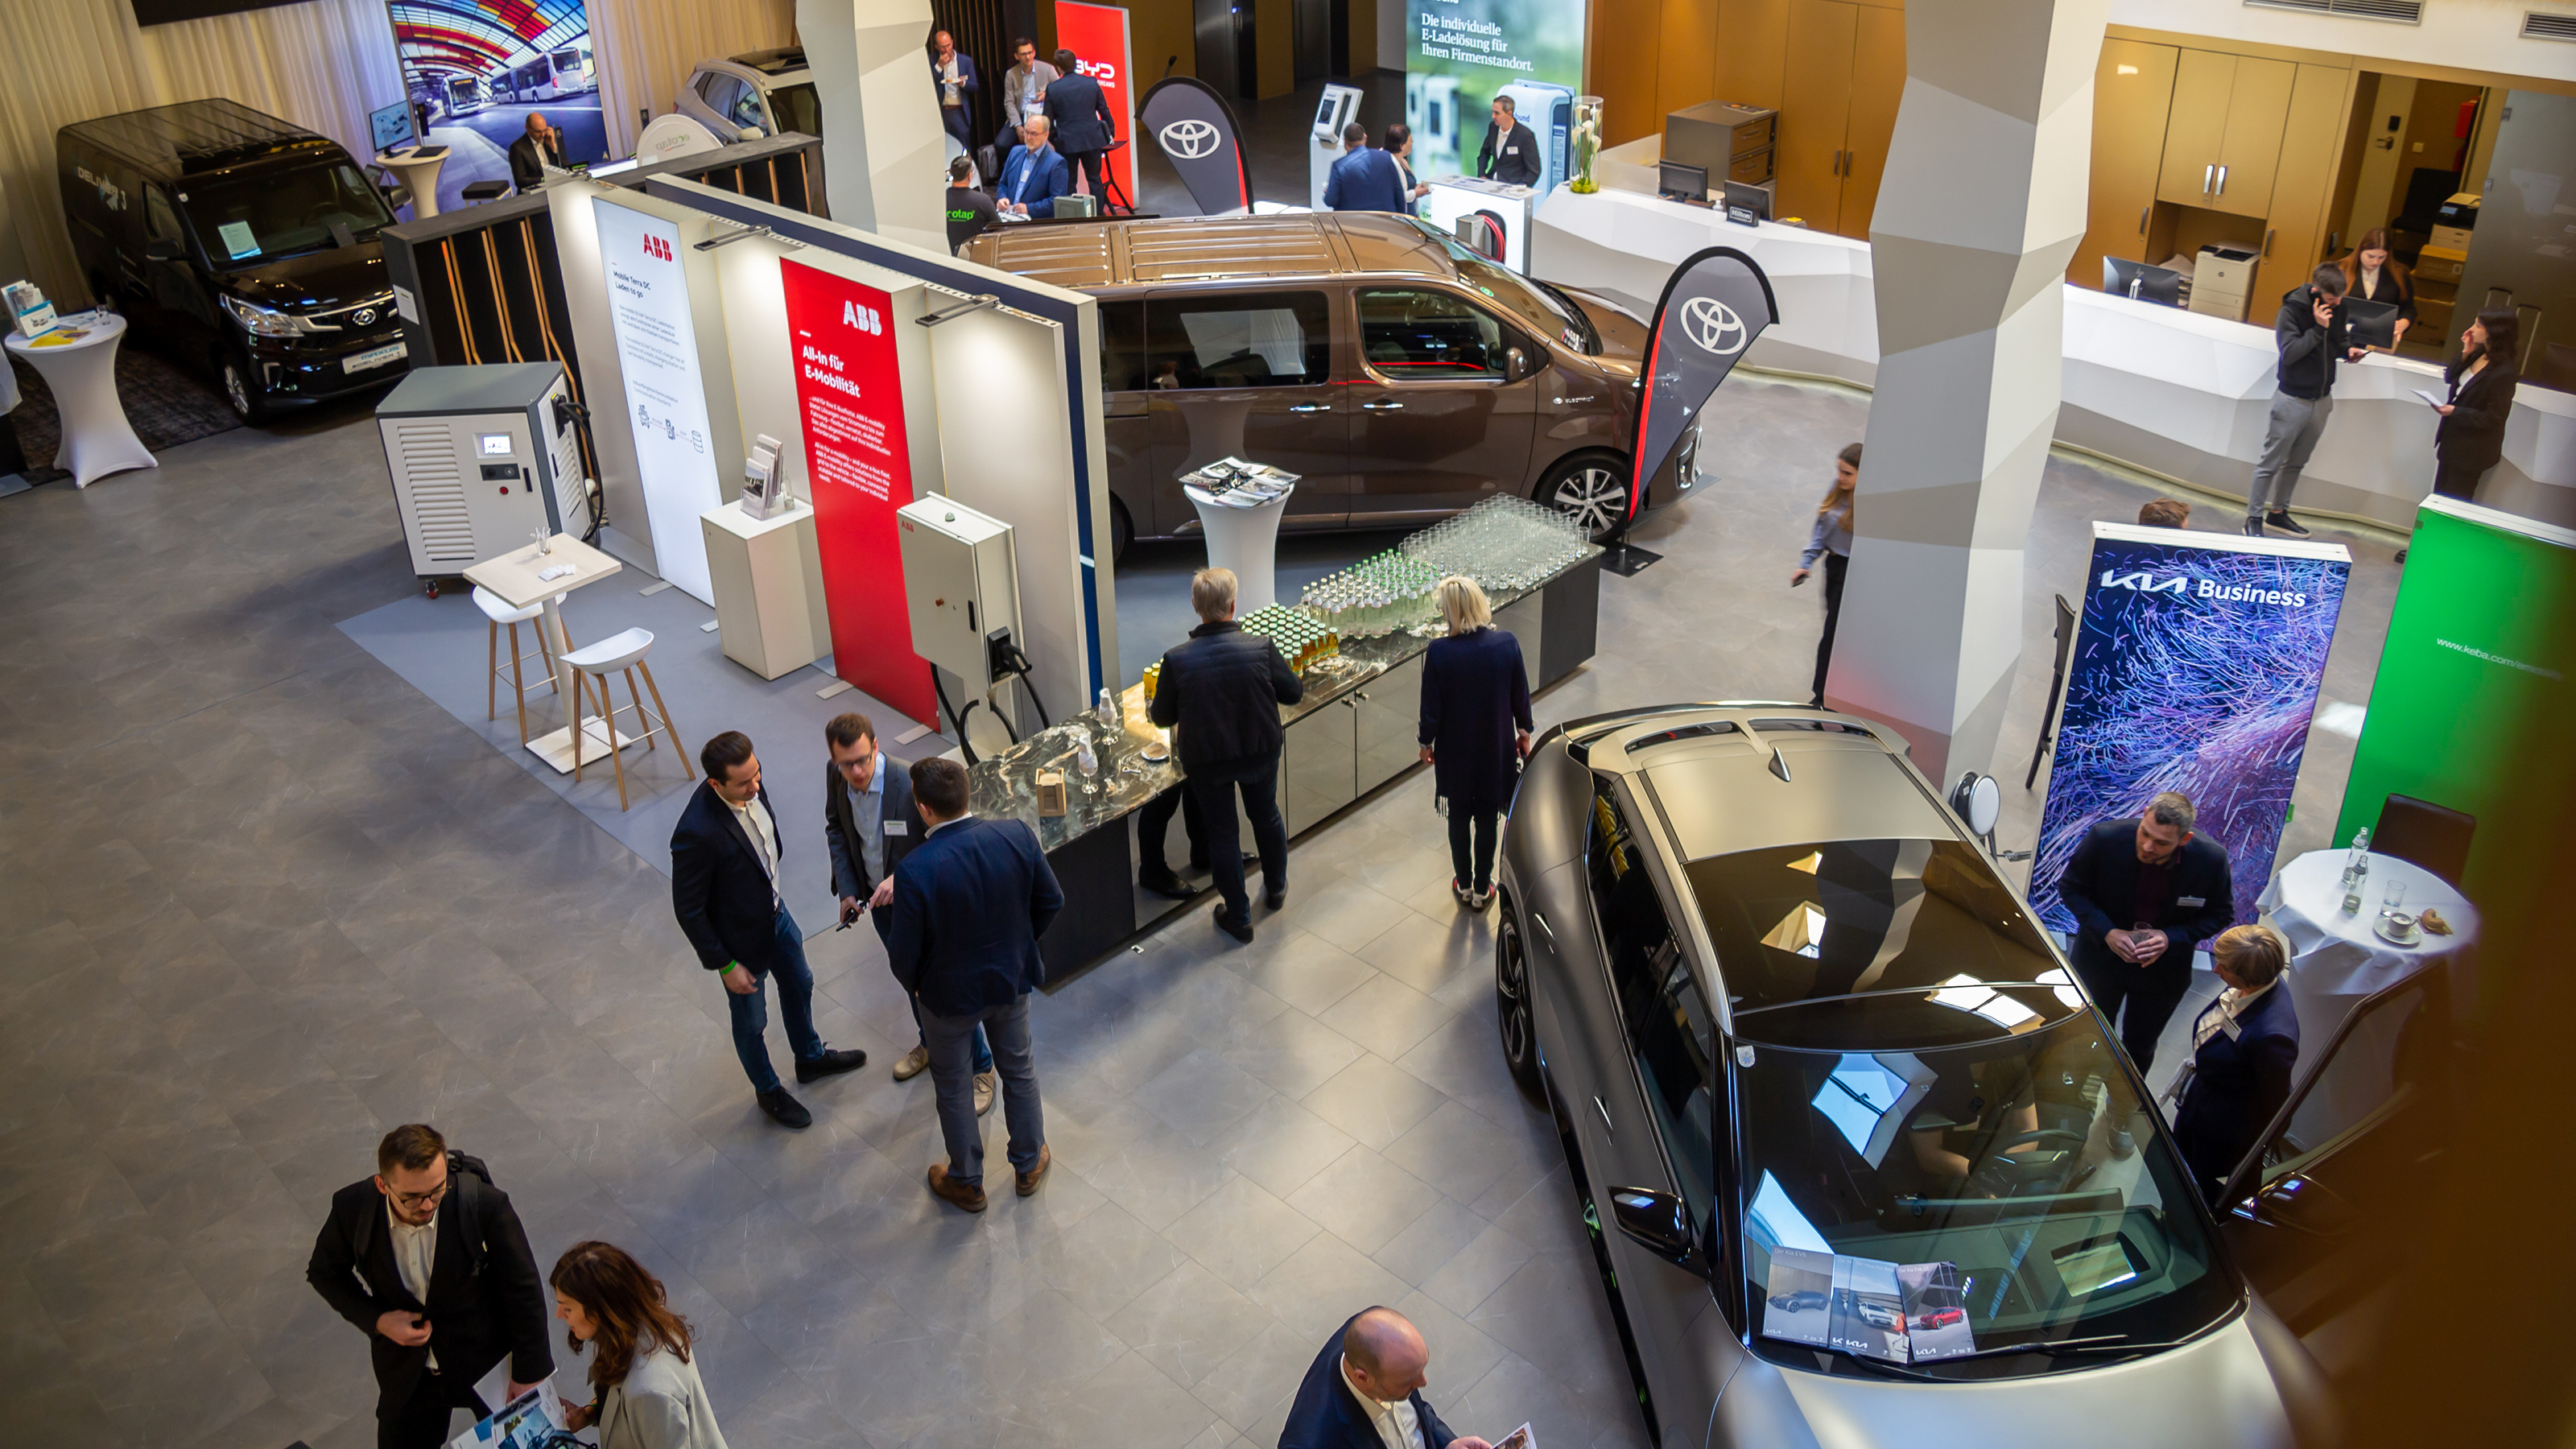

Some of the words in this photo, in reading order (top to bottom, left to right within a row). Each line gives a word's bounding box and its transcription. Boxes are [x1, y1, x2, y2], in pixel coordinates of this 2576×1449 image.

[1422, 13, 1439, 27] Die
[1441, 15, 1501, 36] individuelle
[1422, 27, 1490, 53] E-Ladelösung
[1492, 38, 1508, 52] für
[1075, 59, 1115, 79] BYD
[1422, 43, 1449, 59] Ihren
[1451, 47, 1534, 72] Firmenstandort.
[946, 208, 974, 221] cotap
[1732, 208, 1751, 219] Hilton
[644, 233, 672, 262] ABB
[843, 300, 882, 336] ABB
[803, 345, 828, 366] All-In
[828, 351, 844, 372] für
[804, 365, 861, 398] E-Mobilität
[901, 520, 914, 532] ABB
[2100, 568, 2189, 595] KIA
[2197, 578, 2307, 608] Business
[2437, 638, 2563, 682] www.keba.com/em
[1915, 1348, 1937, 1356] KIA
